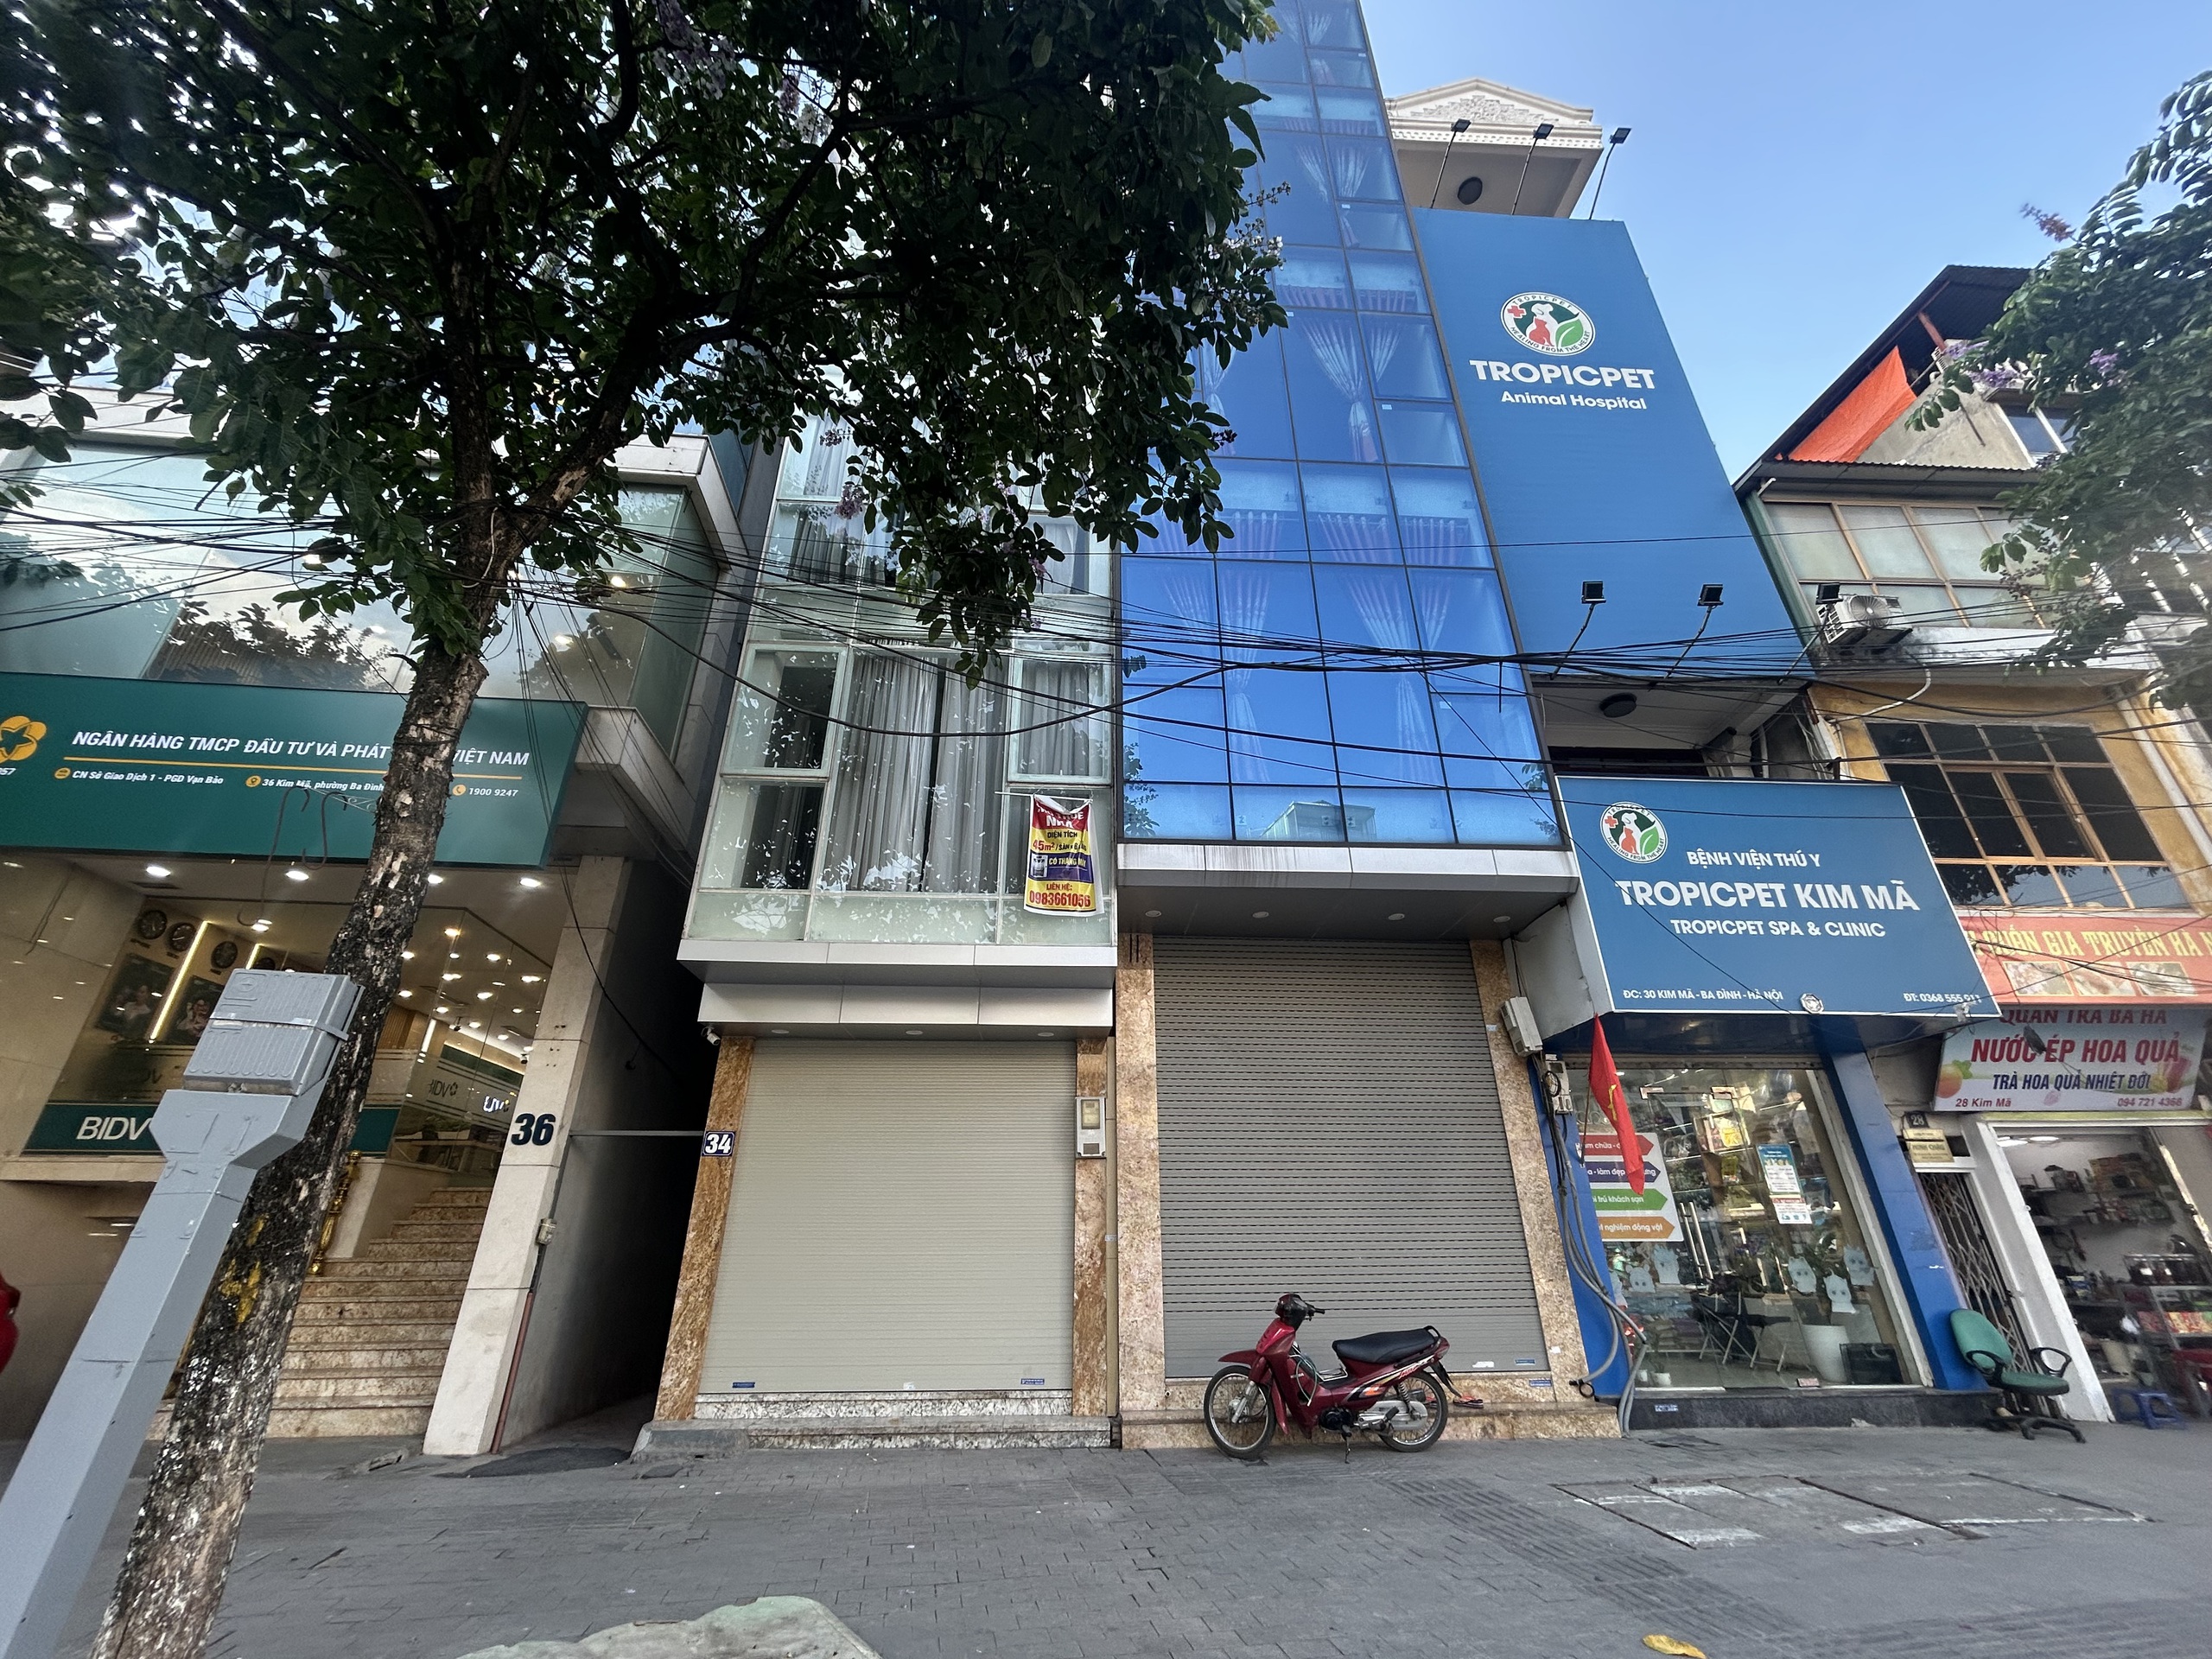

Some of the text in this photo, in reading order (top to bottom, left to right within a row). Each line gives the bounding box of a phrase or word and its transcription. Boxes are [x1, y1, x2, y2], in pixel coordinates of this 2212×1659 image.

[1512, 295, 1573, 308] TROPICPET
[1510, 327, 1539, 348] HEALING
[1578, 330, 1591, 347] HEART
[1469, 359, 1656, 389] TROPICPET
[1501, 391, 1648, 410] Animal Hospital
[72, 730, 130, 747] NGÂN
[129, 733, 185, 750] HÀNG
[188, 737, 239, 752] TMCP
[244, 738, 284, 754] ĐẦU
[287, 741, 315, 756] TƯ
[316, 741, 337, 757] VÀ
[341, 743, 391, 760] PHÁT
[489, 751, 530, 766] NAM
[73, 770, 88, 779] CN
[90, 771, 102, 779] Sở
[104, 772, 124, 780] Giao
[126, 773, 147, 782] Dịch
[164, 774, 184, 783] PGD
[187, 775, 203, 784] Vạn
[314, 781, 347, 791] phường
[468, 787, 518, 797] 1900 9247
[1607, 836, 1630, 857] HEALING
[1647, 852, 1657, 861] THE
[1686, 849, 1821, 870] BỆNH VIỆN THÚ Y
[1046, 882, 1061, 891] LIÊN
[1615, 879, 1921, 911] TROPICPET KIM MÃ
[1029, 890, 1091, 907] 0983661056
[1670, 919, 1885, 938] TROPICPET SPA & CLINIC
[2042, 931, 2082, 957] GIA
[2082, 925, 2170, 957] TRUYỀN
[1623, 989, 1642, 999] ĐC:
[1643, 989, 1656, 999] 30
[1657, 990, 1676, 1000] KIM
[1678, 988, 1695, 1000] MÃ
[1700, 990, 1714, 1000] BA
[1716, 988, 1741, 1000] ĐÌNH
[1747, 988, 1764, 1000] HÀ
[1764, 988, 1783, 1001] NỘI
[1903, 993, 1919, 1001] ĐT:
[1920, 993, 1944, 1002] 0368
[1944, 994, 1964, 1002] 555
[2044, 1034, 2075, 1063] ÉP
[2082, 1039, 2126, 1063] HOA
[2134, 1031, 2179, 1065] QUẢ
[1993, 1070, 2018, 1090] TRÀ
[2022, 1074, 2050, 1090] HOA
[2054, 1070, 2082, 1090] QUẢ
[1955, 1098, 1970, 1107] 28
[1972, 1097, 1993, 1107] Kim
[1995, 1097, 2012, 1107] Mã
[76, 1116, 152, 1141] BIDV
[1910, 1114, 1924, 1125] 28
[511, 1113, 556, 1146] 36
[705, 1134, 731, 1154] 34
